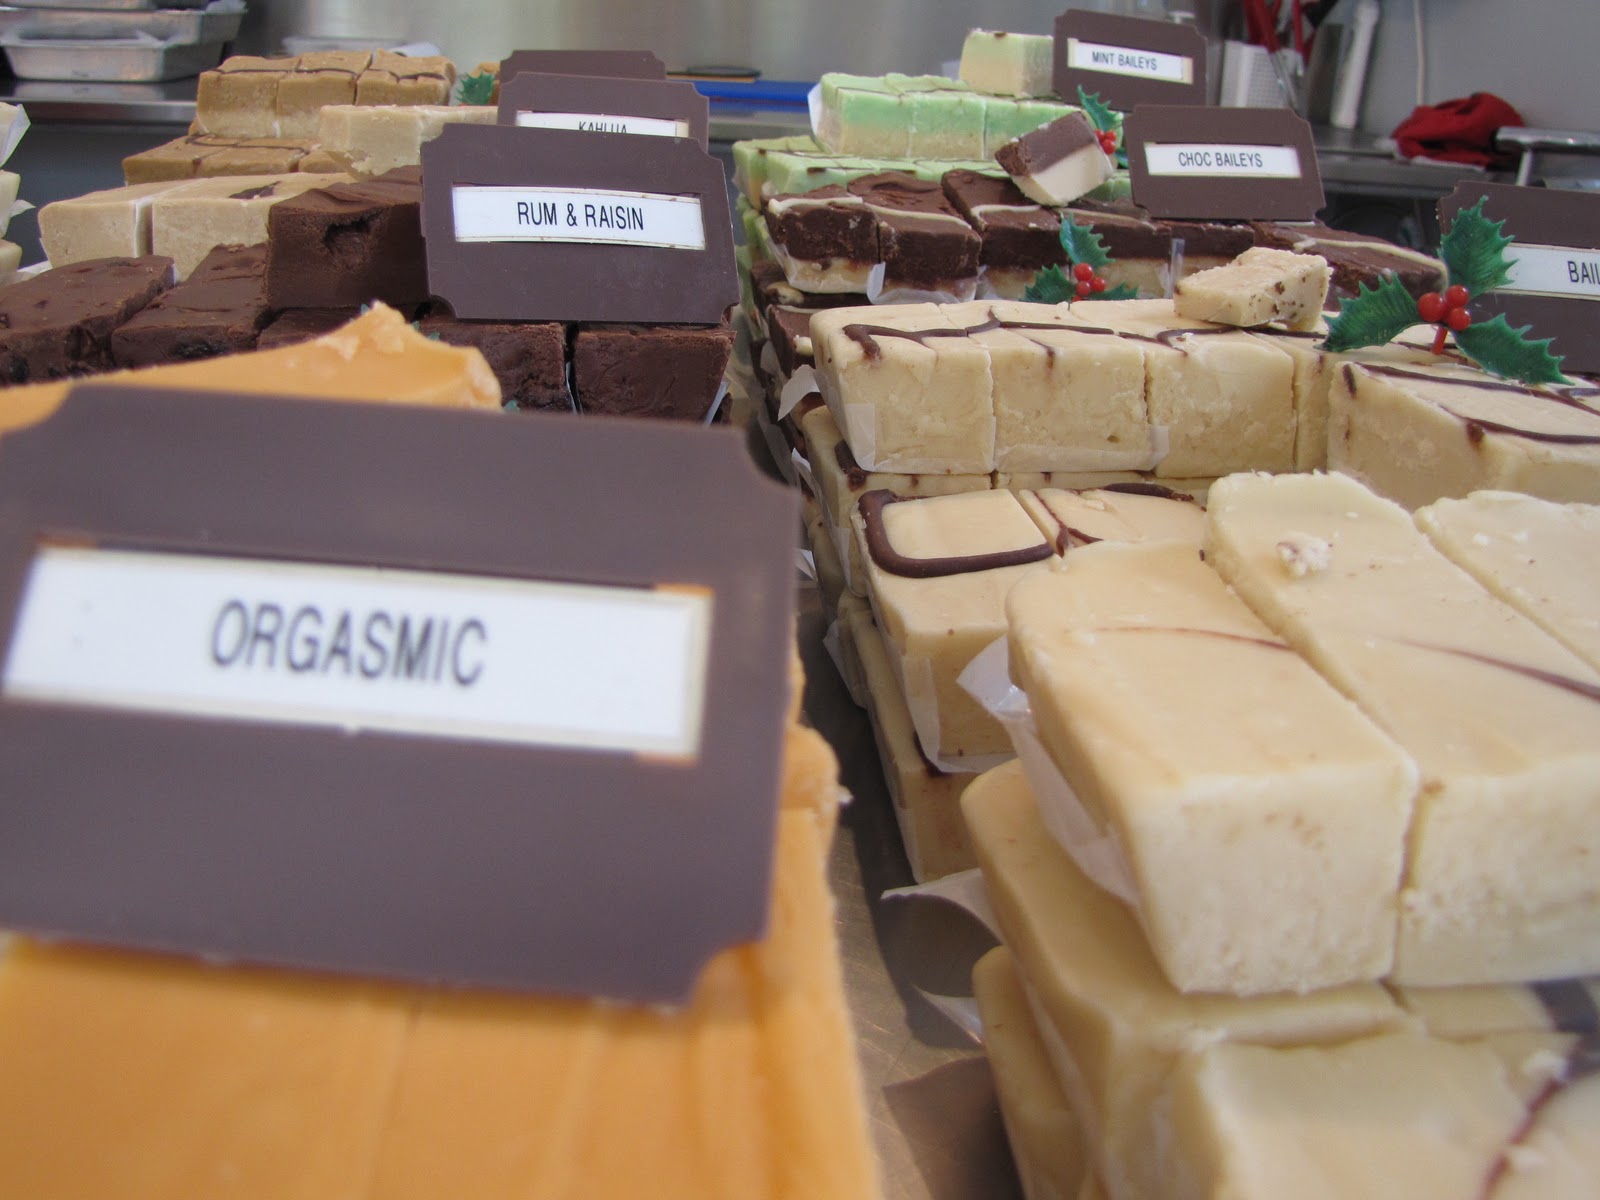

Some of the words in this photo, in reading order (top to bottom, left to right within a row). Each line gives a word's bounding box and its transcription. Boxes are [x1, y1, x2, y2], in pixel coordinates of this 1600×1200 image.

[1092, 51, 1115, 65] MINT
[1118, 54, 1158, 71] BAILEYS
[1178, 152, 1212, 167] CHOC
[1216, 153, 1263, 168] BAILEYS
[517, 201, 558, 226] RUM
[566, 203, 578, 227] &
[584, 204, 645, 231] RAISIN
[210, 599, 488, 688] ORGASMIC
